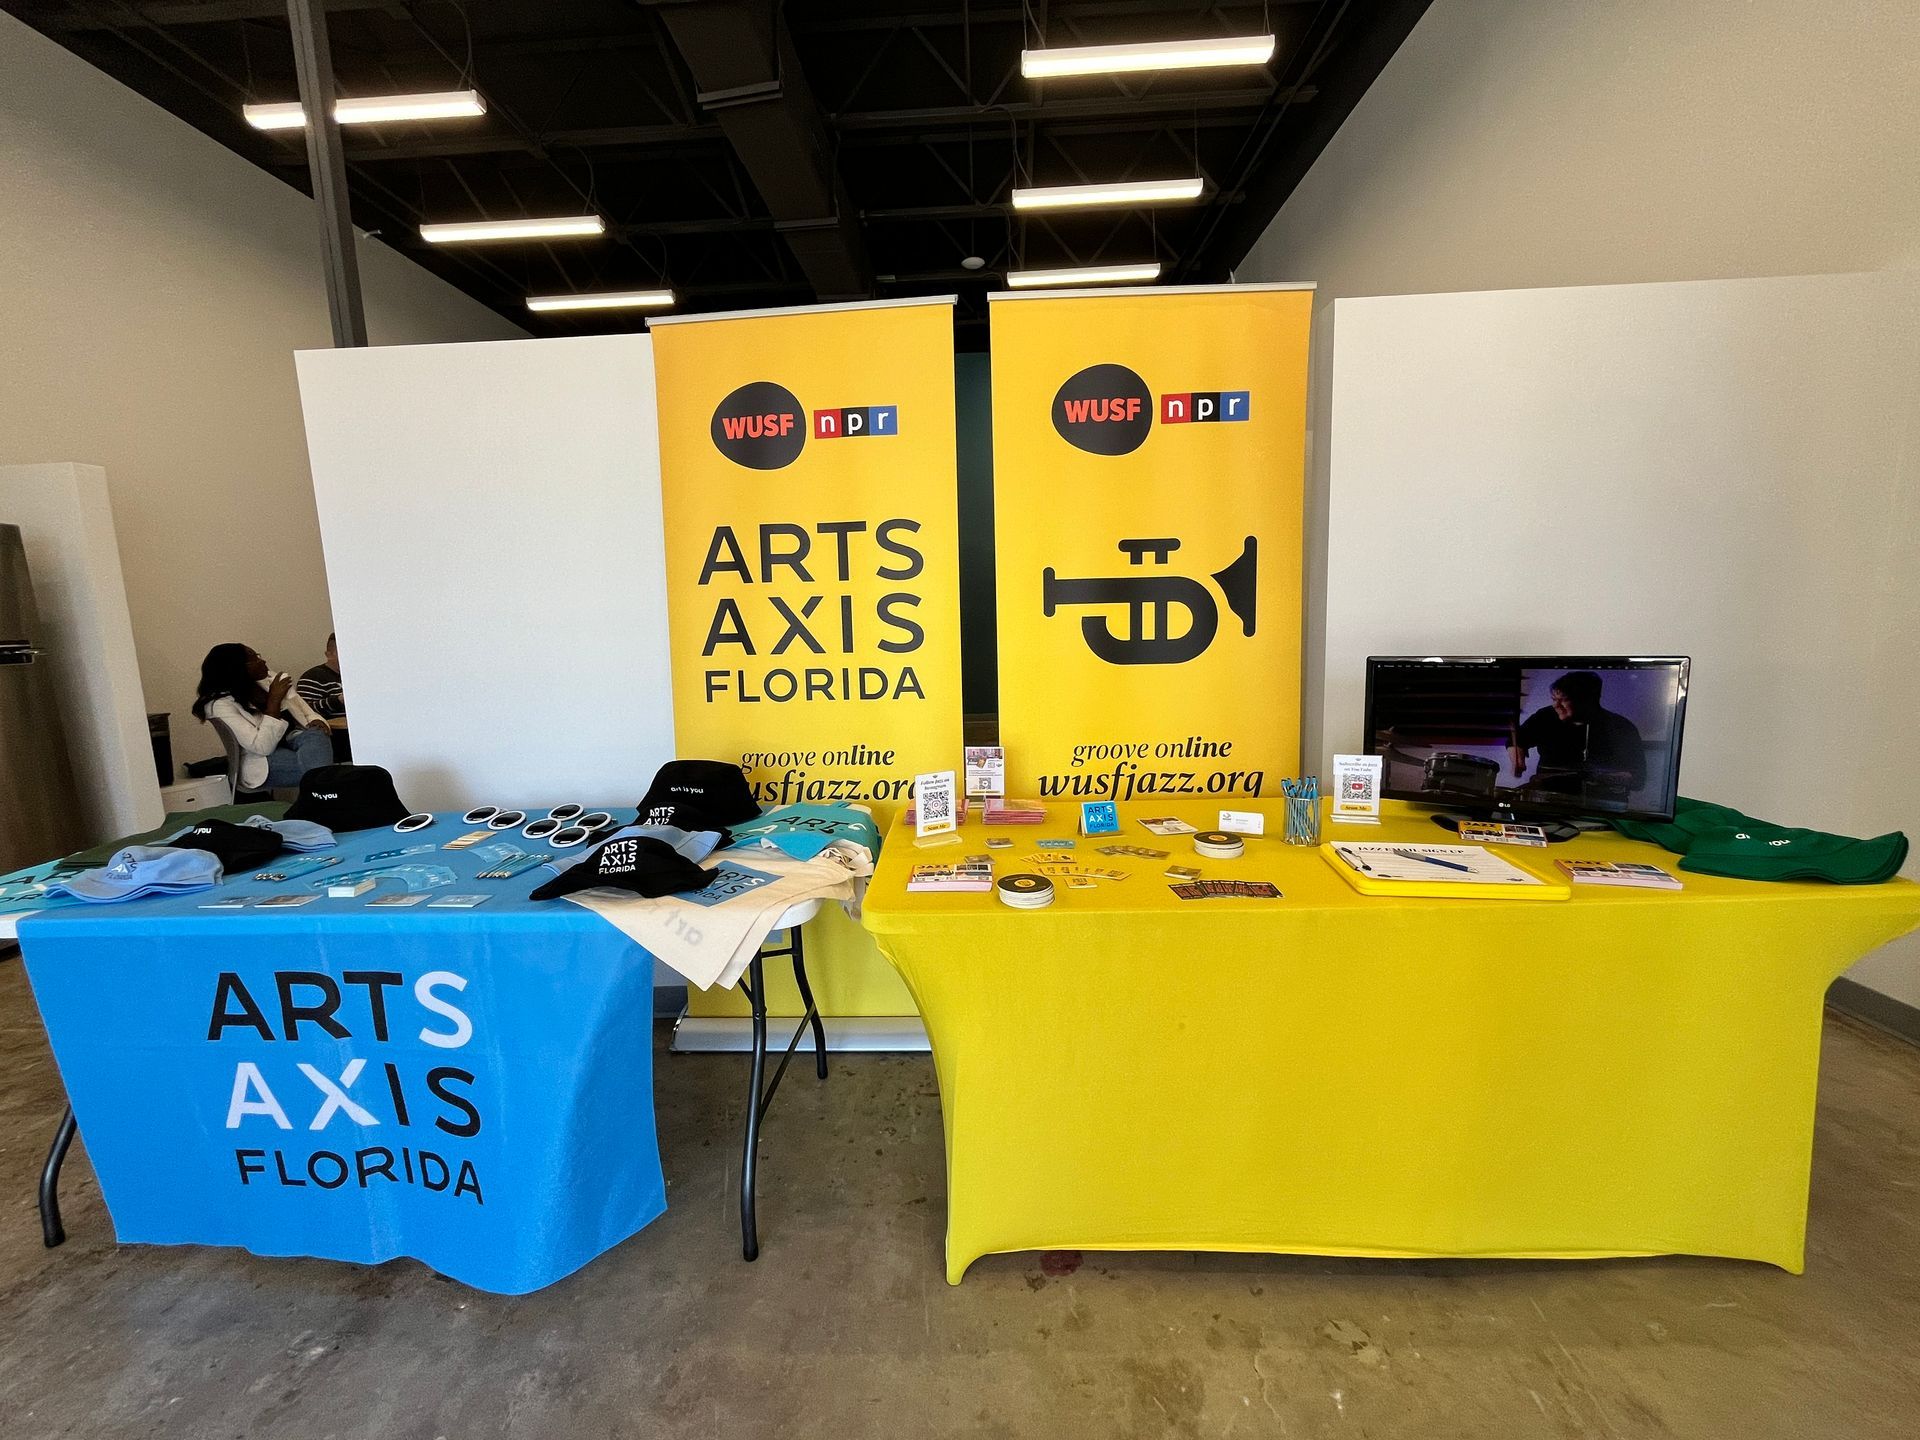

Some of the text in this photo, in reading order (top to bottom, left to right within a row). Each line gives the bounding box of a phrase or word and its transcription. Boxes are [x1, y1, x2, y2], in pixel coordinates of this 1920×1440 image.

[1063, 397, 1141, 424] WUSF
[1167, 396, 1242, 422] npr
[722, 413, 794, 440] WUSF
[819, 410, 891, 436] npr
[697, 518, 925, 586] ARTS
[701, 592, 926, 657] AXIS
[704, 666, 927, 703] FLORIDA
[742, 744, 896, 774] groove online
[1071, 736, 1233, 768] groove online
[322, 793, 338, 801] you
[749, 769, 915, 806] usfjazz.or
[649, 806, 676, 817] ARTS
[1088, 805, 1113, 814] ARTS
[1089, 813, 1114, 822] AXIS
[196, 827, 212, 835] you
[599, 852, 637, 867] AXIS
[602, 839, 638, 857] ARTS
[598, 864, 636, 875] FLORIDA
[206, 970, 474, 1050] ARTS
[225, 1058, 482, 1138] AXIS
[234, 1146, 484, 1206] FLORIDA
